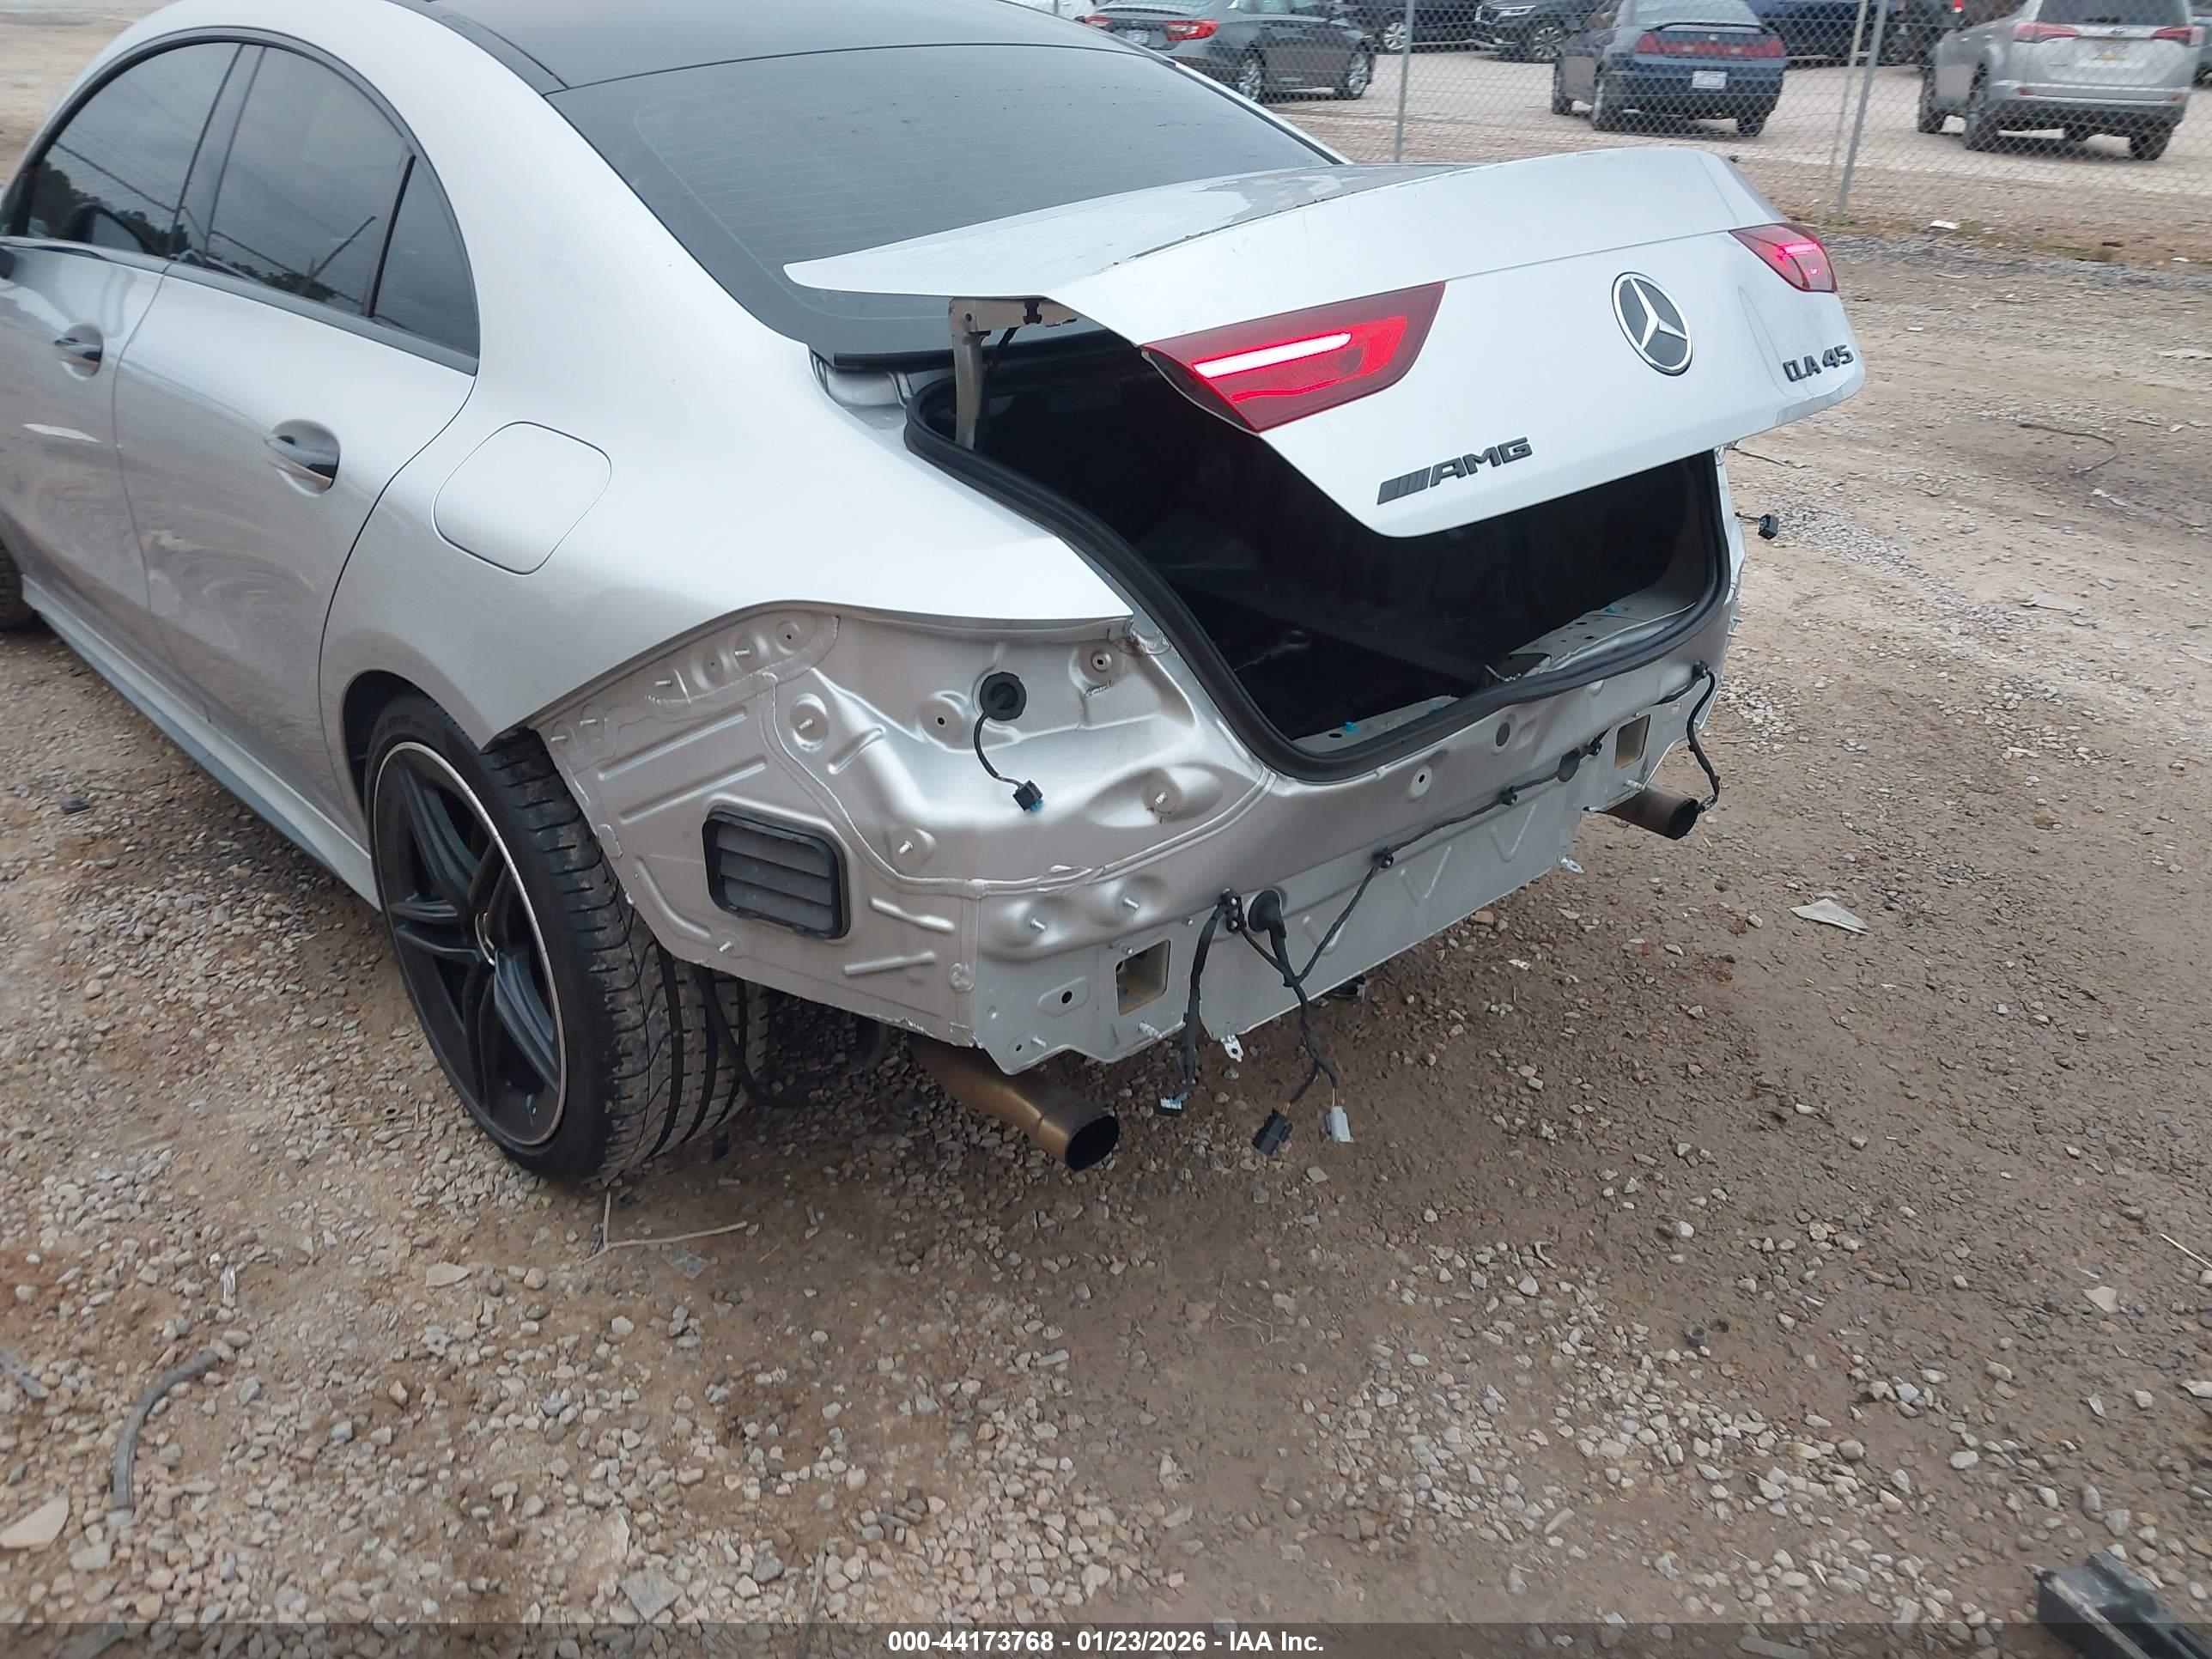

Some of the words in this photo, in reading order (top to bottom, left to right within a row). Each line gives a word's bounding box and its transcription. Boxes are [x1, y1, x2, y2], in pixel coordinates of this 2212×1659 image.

[1783, 355, 1822, 382] CLA
[1822, 344, 1854, 368] 45
[1429, 436, 1533, 488] AMG
